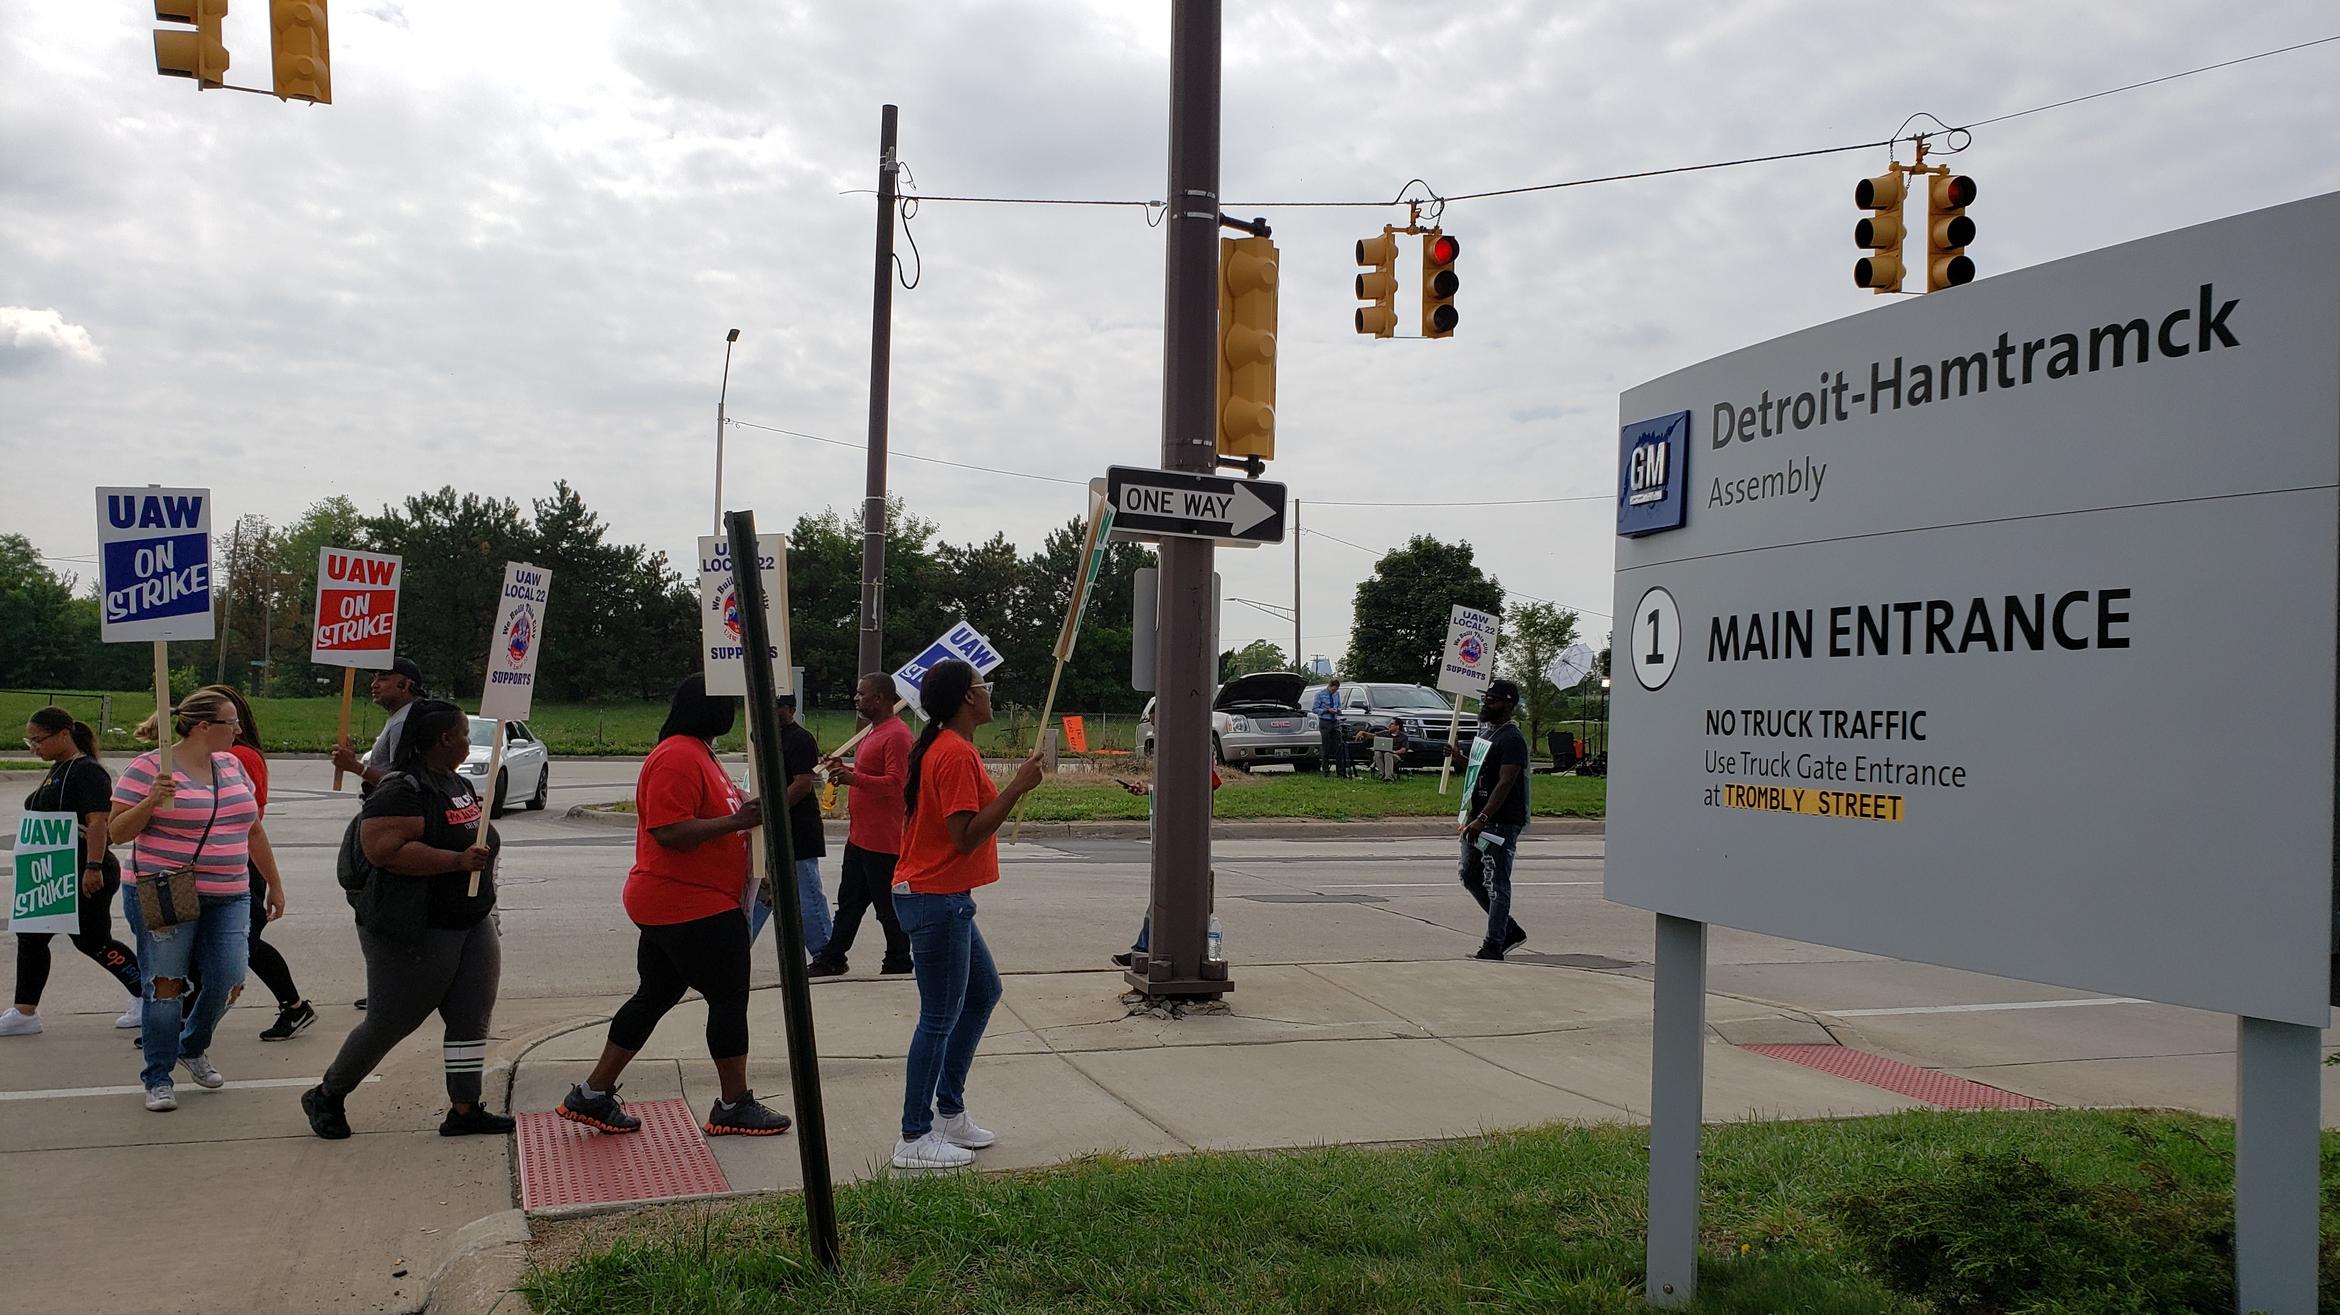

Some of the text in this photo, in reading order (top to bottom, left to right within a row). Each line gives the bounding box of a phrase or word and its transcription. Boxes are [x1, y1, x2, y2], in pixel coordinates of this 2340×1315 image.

[1711, 282, 2241, 450] Detroit-Hamtramck
[1630, 441, 1667, 492] GM
[1707, 455, 1828, 509] Assembly
[107, 495, 204, 529] UAW
[1126, 488, 1233, 519] ONE WAY
[134, 540, 175, 578] ON
[327, 554, 397, 586] UAW
[107, 563, 209, 621] STRIKE
[505, 584, 546, 603] LOCAL 22
[515, 570, 542, 586] UAW
[716, 576, 735, 595] Buil
[340, 592, 371, 619] ON
[1462, 610, 1489, 624] UAW
[317, 612, 394, 648] STRIKE
[1453, 617, 1495, 636] LOCAL 22
[1644, 608, 1665, 665] 1
[1707, 588, 2132, 662] MAIN ENTRANCE
[711, 645, 779, 660] SUPPS
[949, 626, 998, 669] UAW
[491, 671, 532, 686] SUPPORTS
[1446, 664, 1487, 681] SUPPORTS
[1705, 709, 1927, 741] NO TRUCK TRAFFIC
[1704, 749, 1967, 788] Use Truck Gate Entrance
[1703, 783, 1902, 820] at TROMBLY STREET
[19, 818, 73, 846] UAW
[31, 854, 53, 884] ON
[14, 873, 76, 917] STRIKE
